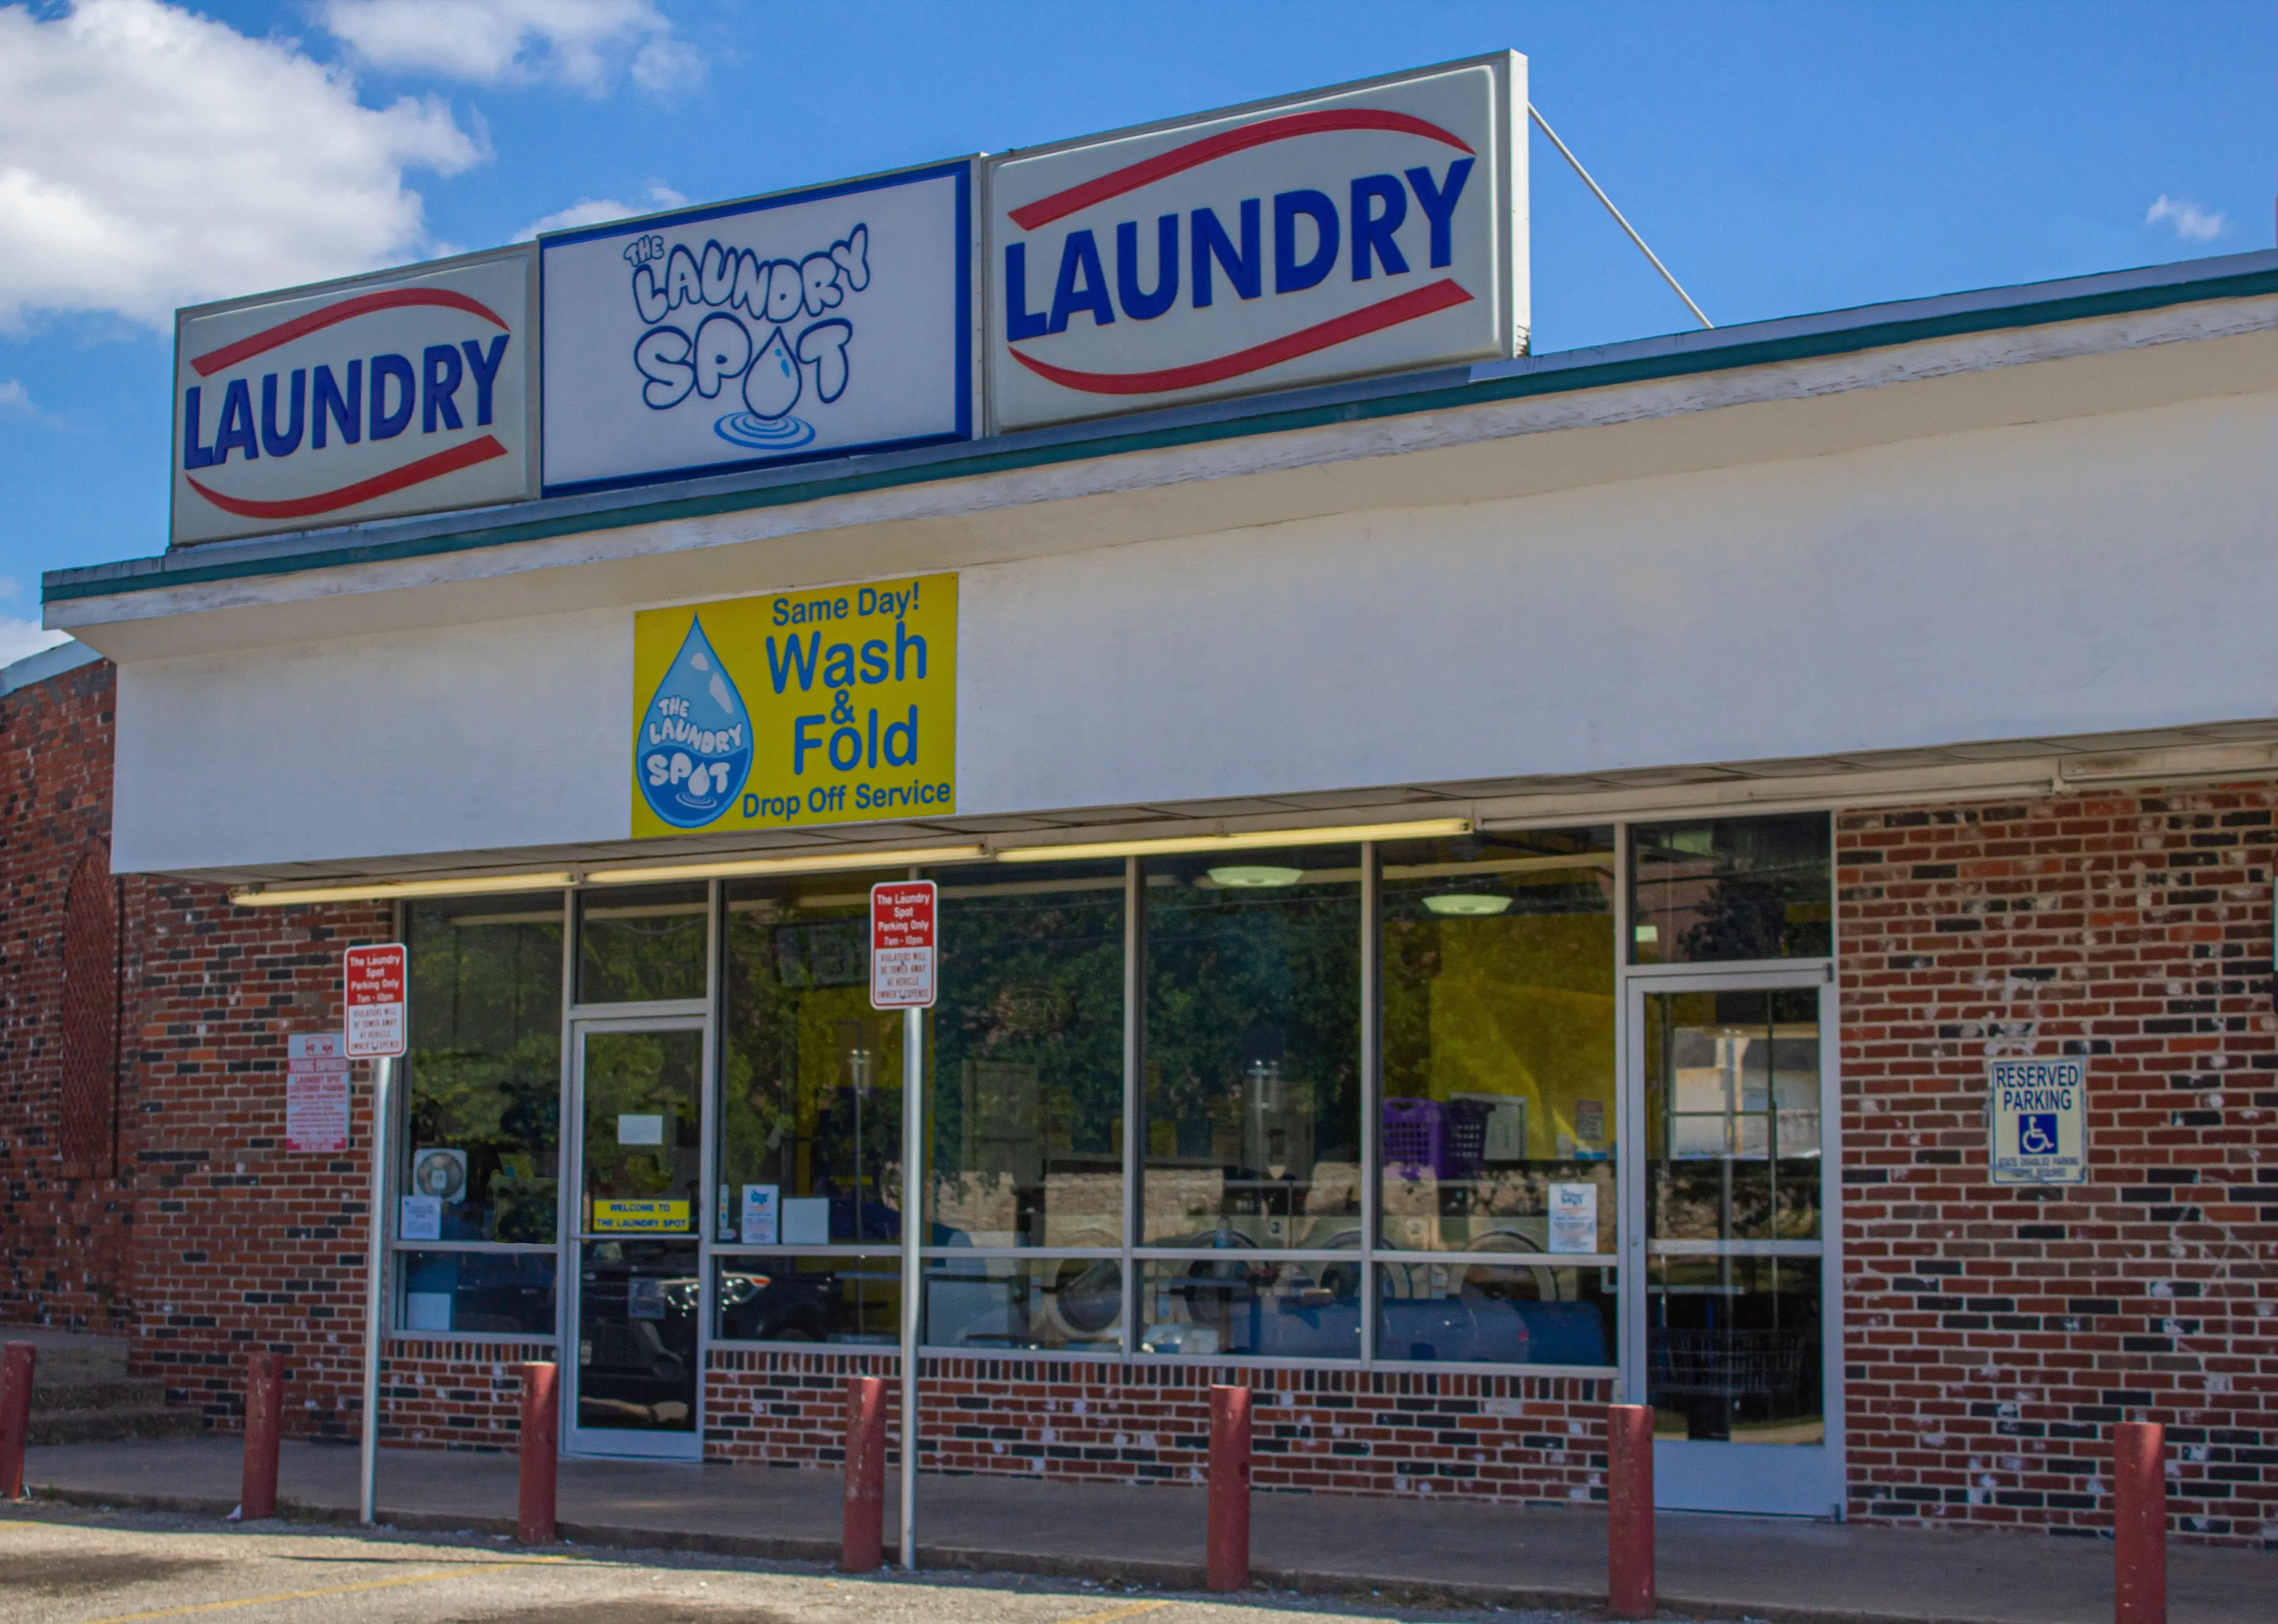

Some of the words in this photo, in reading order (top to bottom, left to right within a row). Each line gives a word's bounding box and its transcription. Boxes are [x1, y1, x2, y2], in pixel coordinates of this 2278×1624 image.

[624, 234, 665, 266] THE
[1005, 158, 1475, 342] LAUNDRY
[633, 223, 870, 324] LAUNDRY
[634, 311, 853, 420] SPOT
[184, 334, 510, 470] LAUNDRY
[773, 598, 848, 626] Same
[858, 582, 920, 620] Day!
[765, 621, 926, 694] Wash
[659, 694, 690, 718] THE
[832, 689, 855, 725] &
[648, 718, 742, 754] LAUNDRY
[794, 704, 917, 775] Fold
[647, 752, 730, 796] SPOT
[743, 794, 800, 820] Drop
[809, 785, 846, 812] Off
[856, 780, 950, 809] Service
[877, 895, 892, 905] The
[895, 893, 930, 905] Laundry
[894, 906, 914, 919] Spot
[878, 921, 908, 933] Parking
[911, 920, 929, 932] Only
[350, 956, 365, 967] The
[367, 955, 401, 966] Laundry
[366, 967, 384, 979] Spot
[351, 981, 380, 992] Parking
[382, 979, 399, 990] Only
[1996, 1065, 2078, 1088] RESERVED
[2004, 1089, 2072, 1111] PARKING
[597, 1219, 613, 1227] THE
[617, 1219, 659, 1227] LAUNDRY
[663, 1219, 686, 1227] SPOT
[610, 1203, 654, 1212] WELCOME
[659, 1203, 670, 1211] TO
